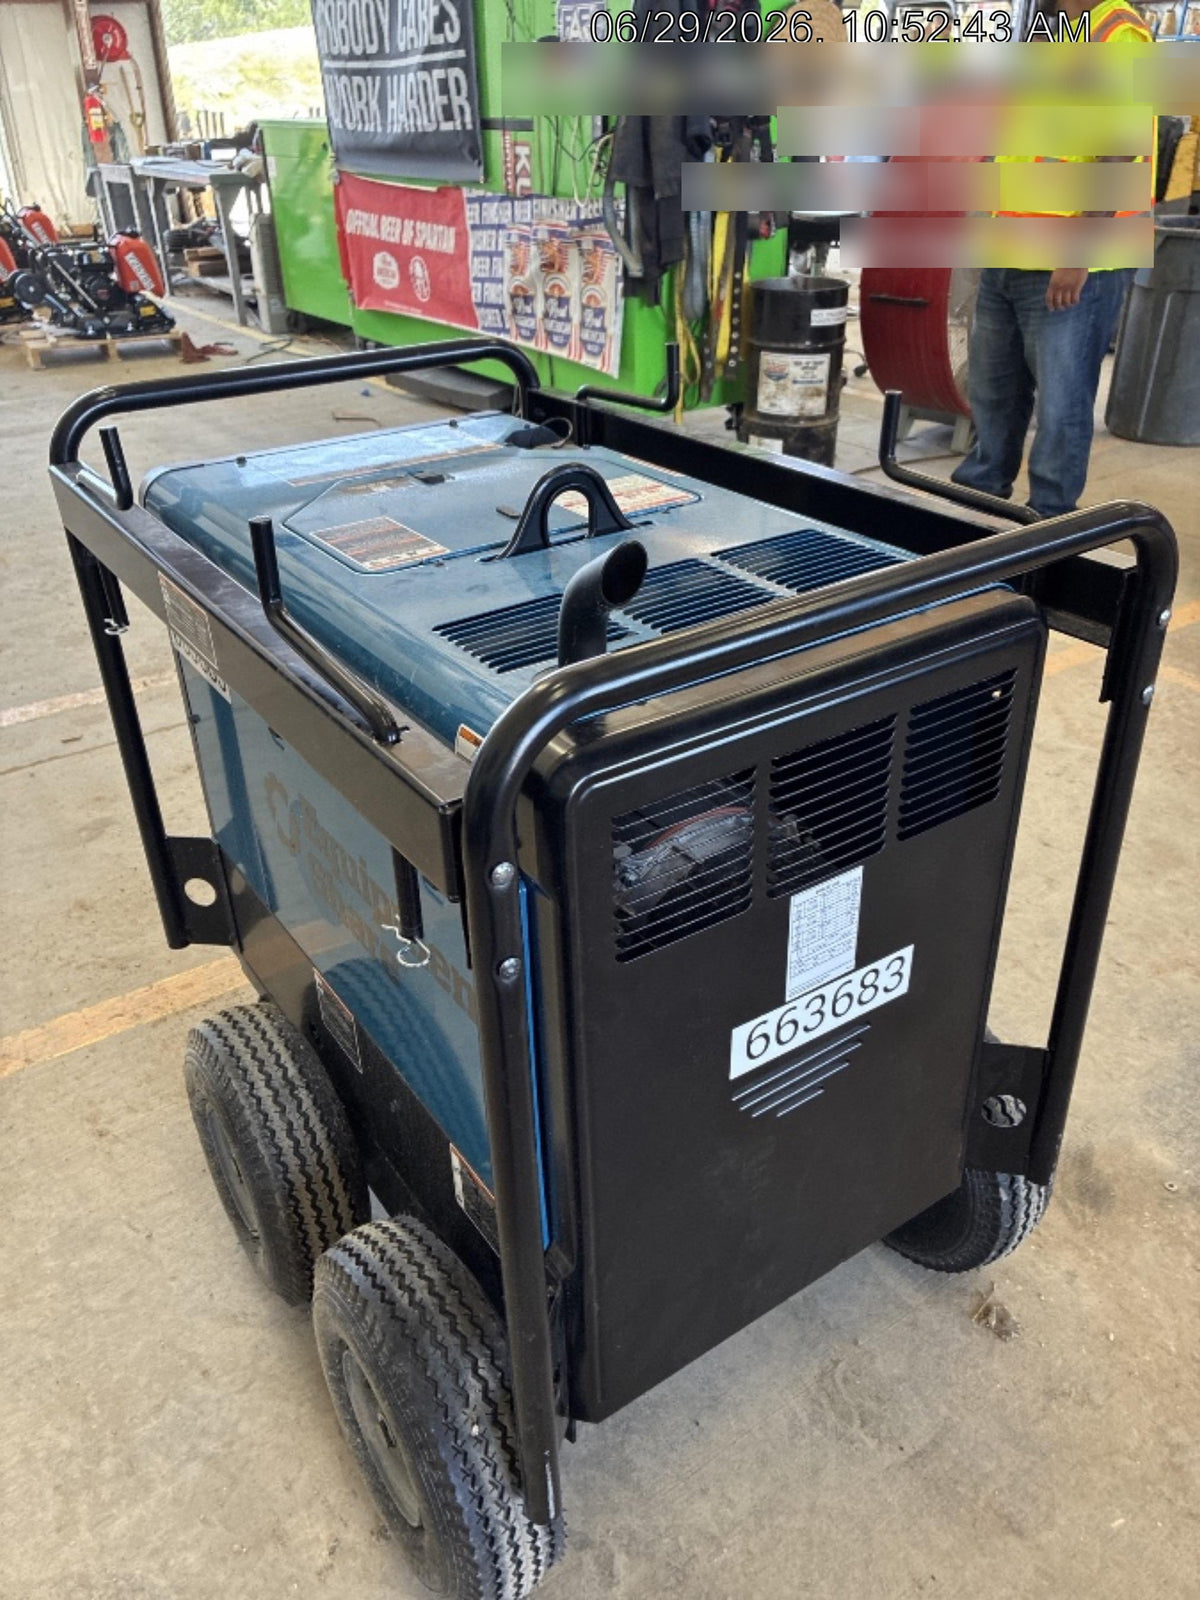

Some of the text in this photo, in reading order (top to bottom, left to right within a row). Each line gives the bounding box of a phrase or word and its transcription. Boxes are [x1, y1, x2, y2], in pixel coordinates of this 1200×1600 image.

[397, 0, 462, 53] CARES
[324, 67, 473, 134] WORK HARDER
[381, 214, 402, 245] BEER
[402, 218, 416, 247] OF
[746, 956, 905, 1060] 663683
